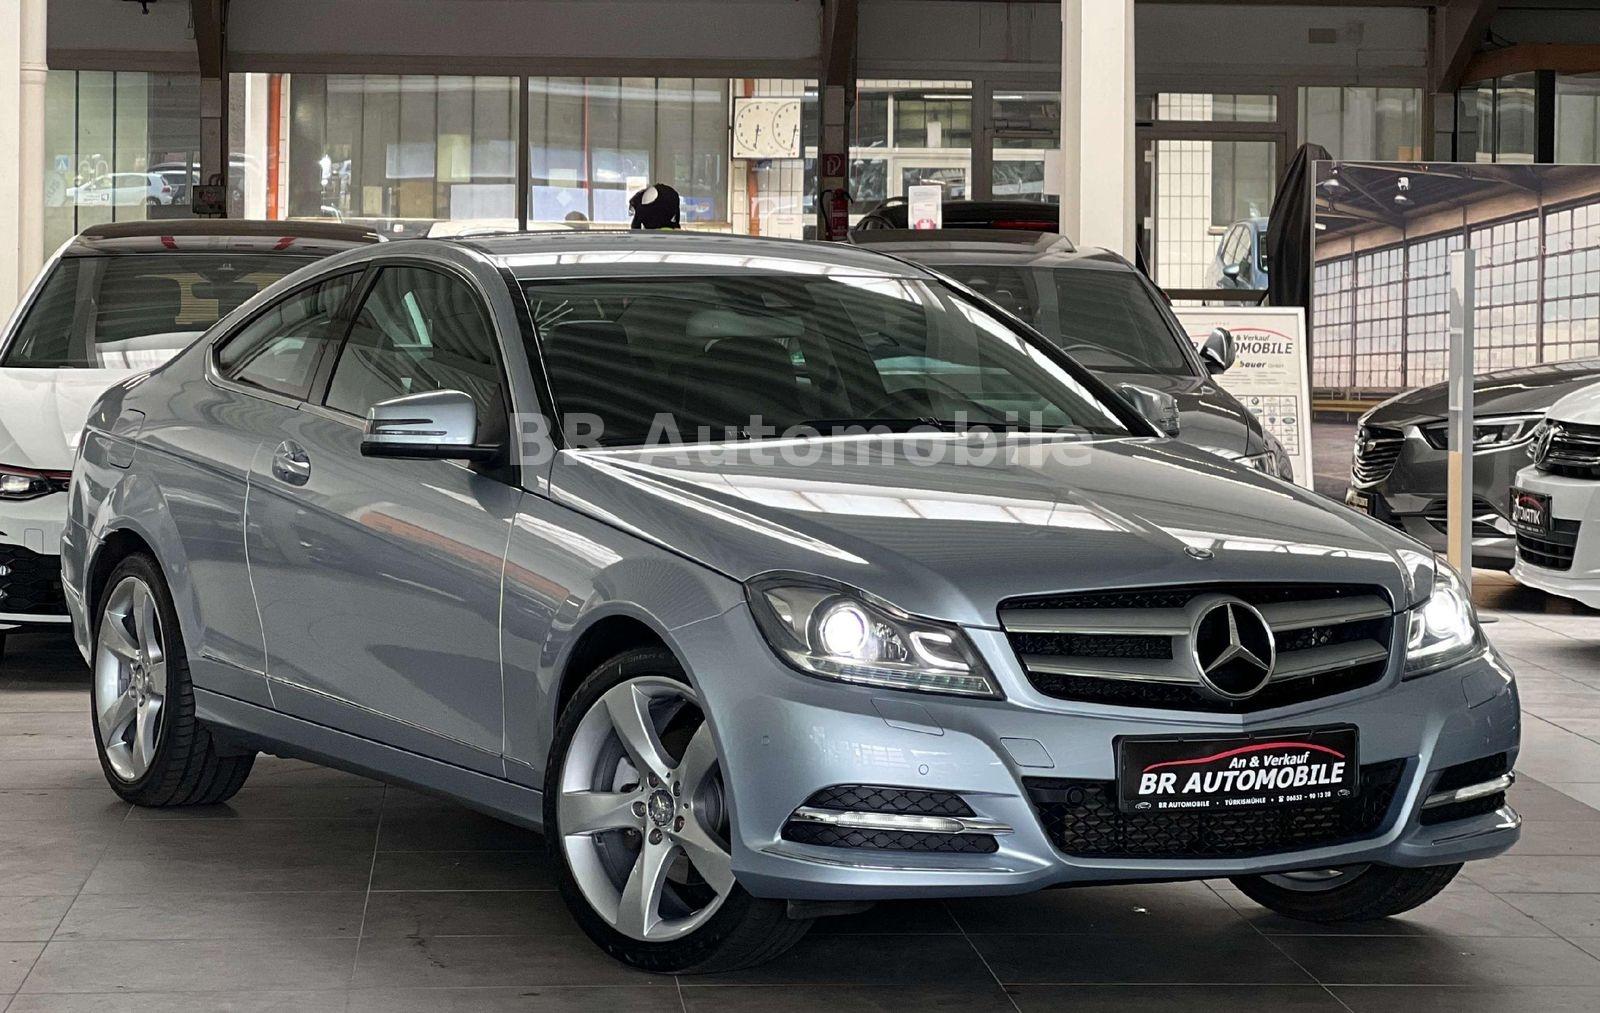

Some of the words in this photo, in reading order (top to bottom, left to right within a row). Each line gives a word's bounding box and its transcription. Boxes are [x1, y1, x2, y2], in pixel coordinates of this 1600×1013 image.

[1243, 334, 1271, 342] Verkauf
[1234, 342, 1294, 354] OMOBILE
[1229, 756, 1246, 770] An
[1249, 755, 1260, 768] &
[1264, 751, 1310, 767] Verkauf
[1138, 771, 1177, 795] BR
[1182, 762, 1345, 794] AUTOMOBILE
[1158, 801, 1168, 809] BR
[1168, 800, 1210, 808] AUTOMOBILE
